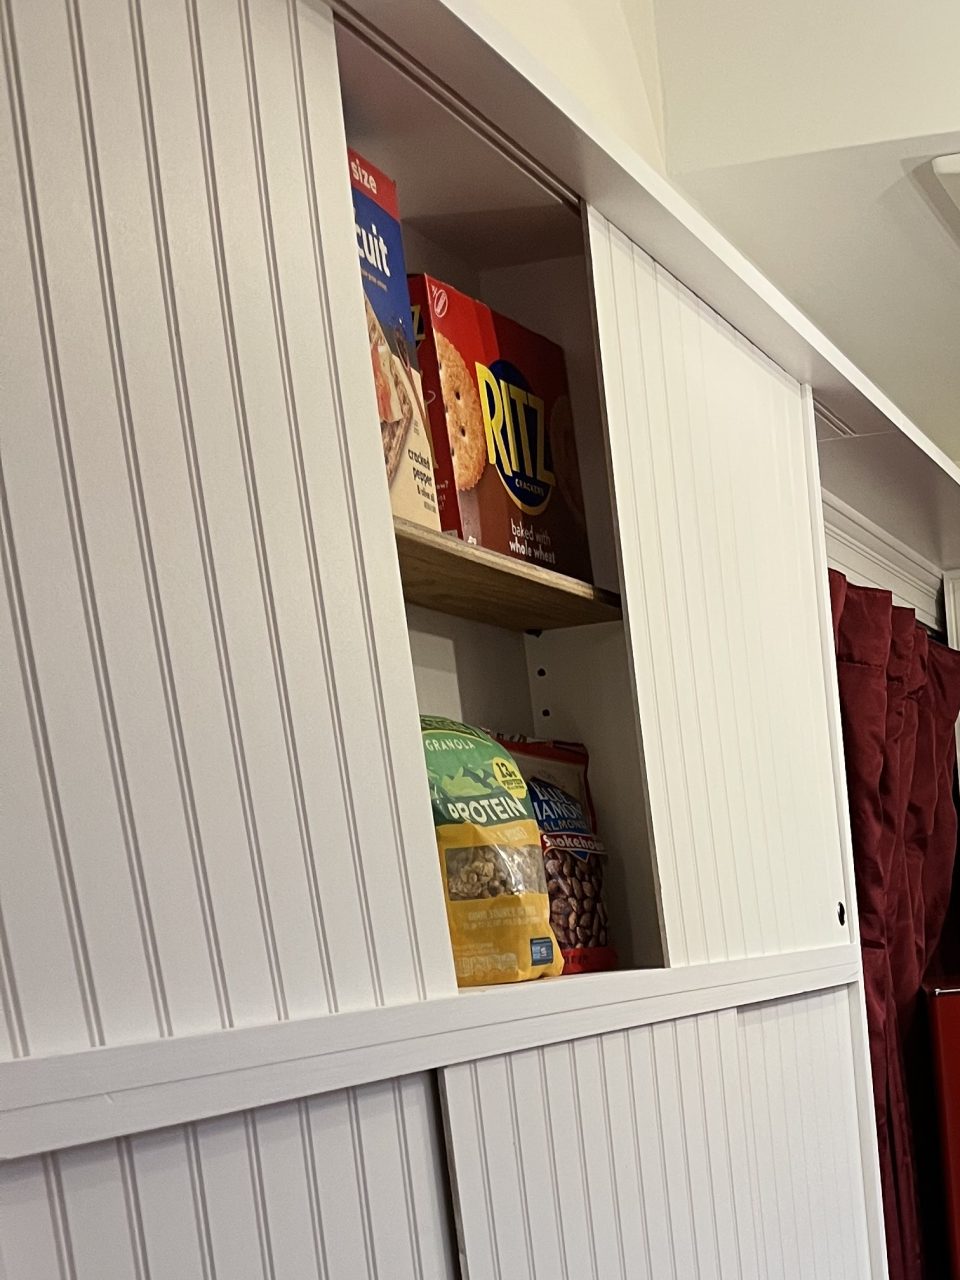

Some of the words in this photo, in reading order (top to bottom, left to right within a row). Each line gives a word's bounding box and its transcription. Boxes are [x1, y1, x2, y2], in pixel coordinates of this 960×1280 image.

[350, 158, 377, 195] size
[475, 361, 556, 487] RITZ
[515, 478, 545, 497] CRACKERS
[510, 517, 534, 541] baked
[535, 528, 551, 546] with
[509, 536, 533, 557] whole
[533, 544, 556, 565] wheat
[425, 739, 476, 751] GRANOLA
[447, 796, 528, 823] PROTEIN
